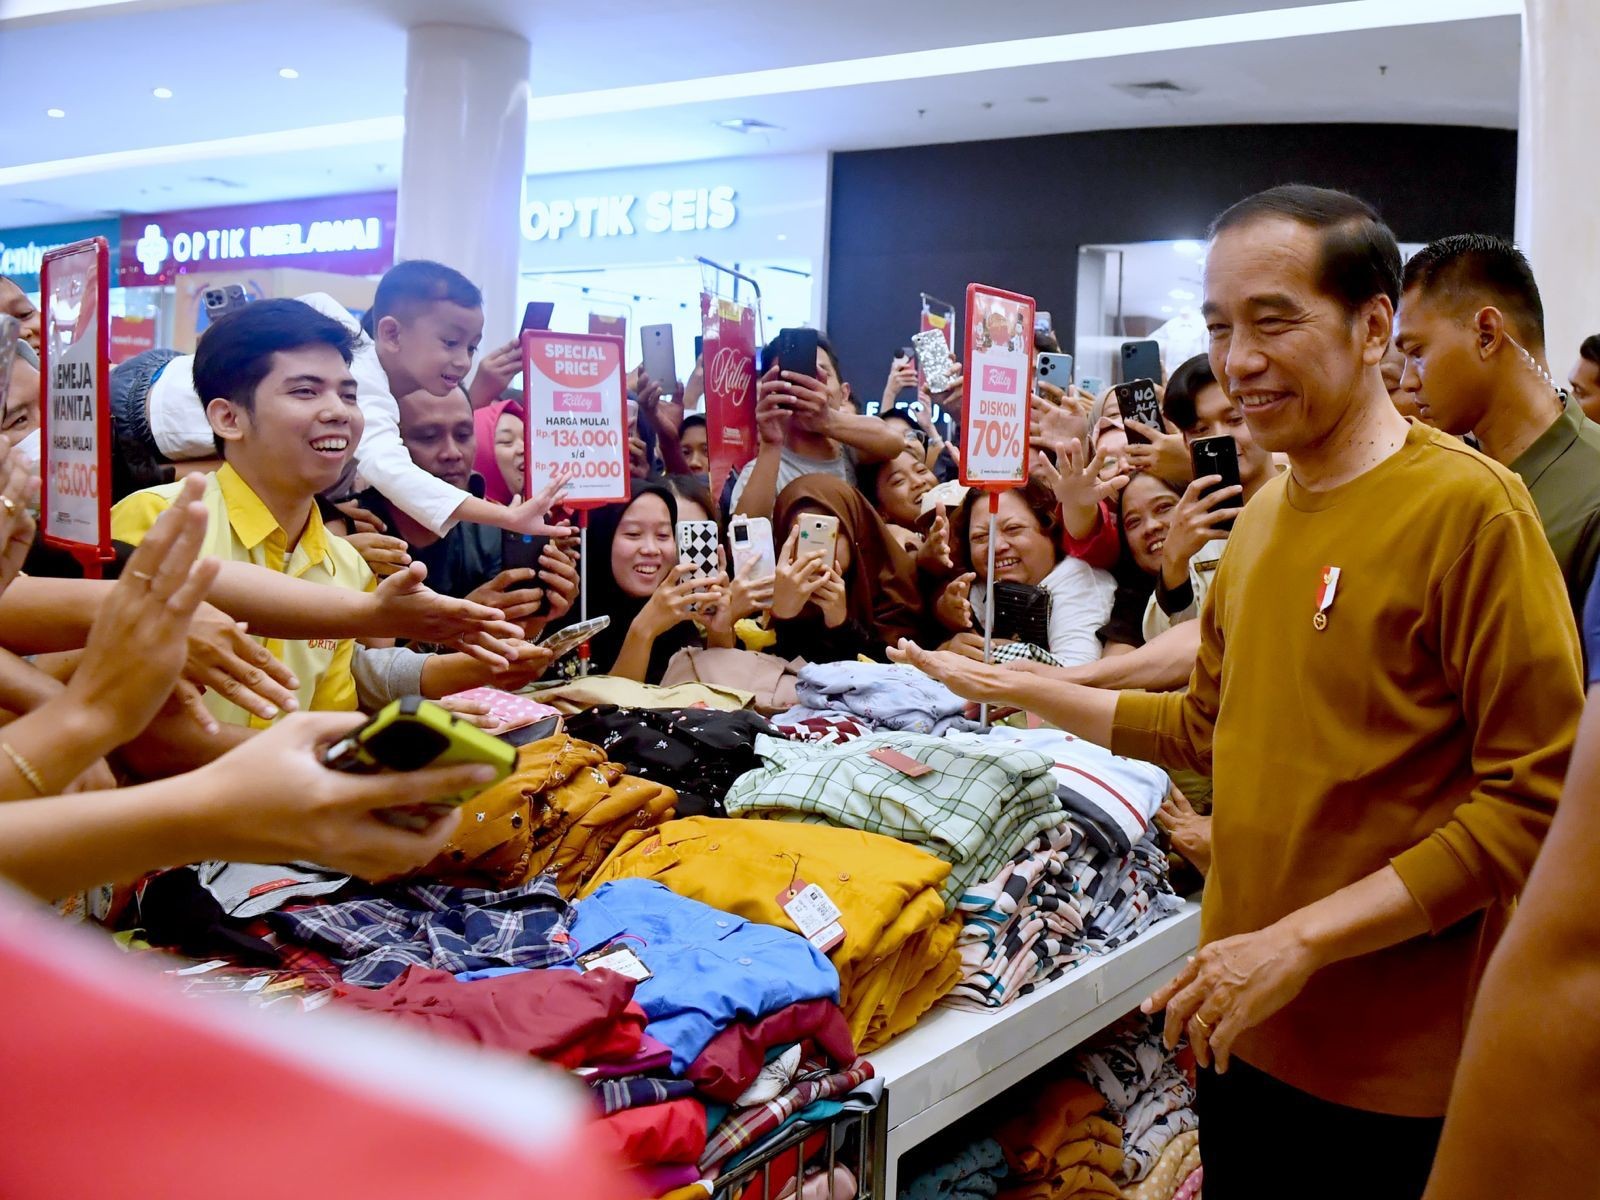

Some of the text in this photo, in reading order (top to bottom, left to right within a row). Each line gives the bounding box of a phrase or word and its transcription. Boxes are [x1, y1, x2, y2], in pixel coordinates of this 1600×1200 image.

[520, 185, 736, 241] OPTIK SEIS
[173, 217, 380, 263] OPTIK MELAWAI
[544, 343, 607, 361] SPECIAL
[554, 360, 599, 376] PRICE
[562, 393, 593, 410] Rilley
[1134, 387, 1154, 402] NO
[54, 395, 93, 421] WANITA
[980, 400, 1017, 417] DISKON
[545, 416, 609, 427] HARGA MULAI
[73, 436, 93, 452] MULAI
[551, 429, 618, 447] 136.000
[973, 420, 1020, 457] 70%
[571, 450, 585, 459] s/d
